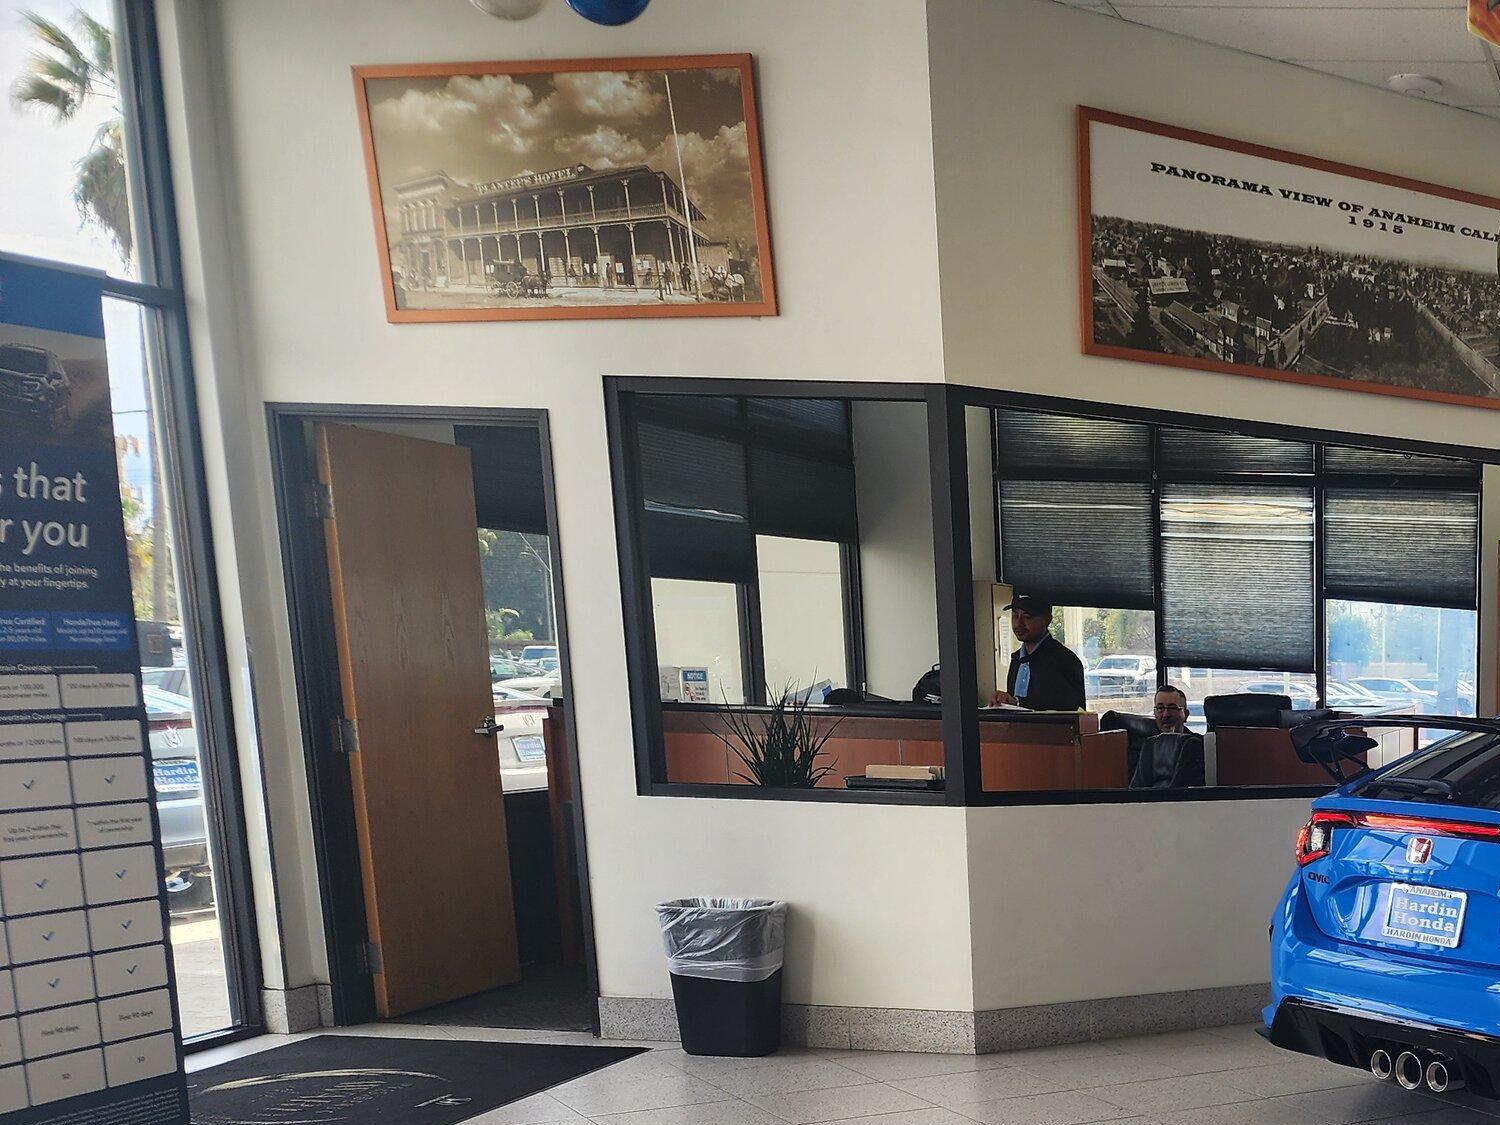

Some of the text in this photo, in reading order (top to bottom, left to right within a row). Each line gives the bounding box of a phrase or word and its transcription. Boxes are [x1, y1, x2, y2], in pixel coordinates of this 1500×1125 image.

[1150, 161, 1500, 242] PANORAMA VIEW OF ANAHEIM CALI
[13, 461, 87, 502] that
[22, 518, 88, 555] you
[14, 563, 52, 574] benefits
[53, 564, 64, 574] of
[65, 565, 98, 579] joining
[20, 579, 41, 589] your
[1409, 886, 1447, 898] ANAHEIM
[1396, 897, 1457, 918] Hardin
[1394, 911, 1455, 933] Honda
[1387, 927, 1452, 946] HARDIN HONDA
